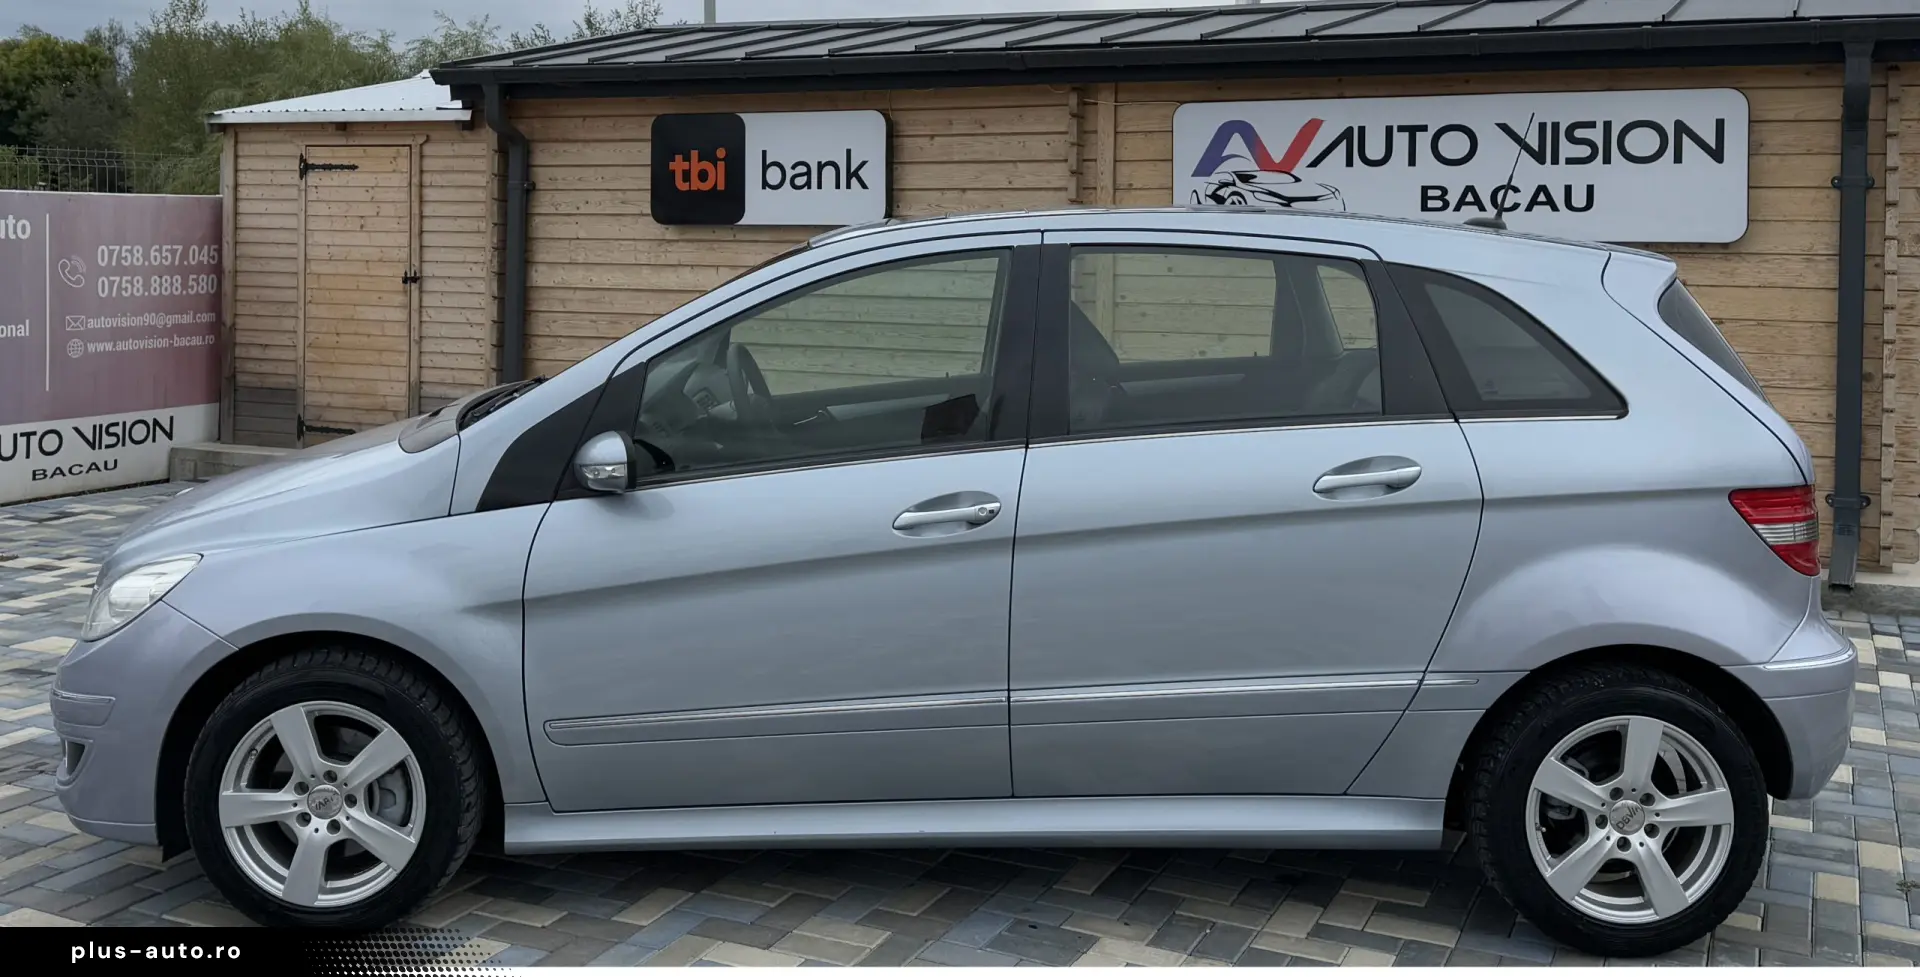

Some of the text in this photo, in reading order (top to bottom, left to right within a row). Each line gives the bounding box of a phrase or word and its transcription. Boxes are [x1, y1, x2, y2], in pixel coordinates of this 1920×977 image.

[1305, 118, 1725, 168] AUTO VISION
[669, 147, 870, 191] tbi bank
[1420, 184, 1595, 213] BACAU
[97, 244, 219, 267] 0758.657.045
[97, 274, 218, 298] 0758.888.580
[87, 310, 216, 329] autovision90@gmail.com
[87, 334, 215, 353] www.autovision-bacau.ro
[72, 415, 174, 451] VISION
[31, 458, 118, 481] BACAU
